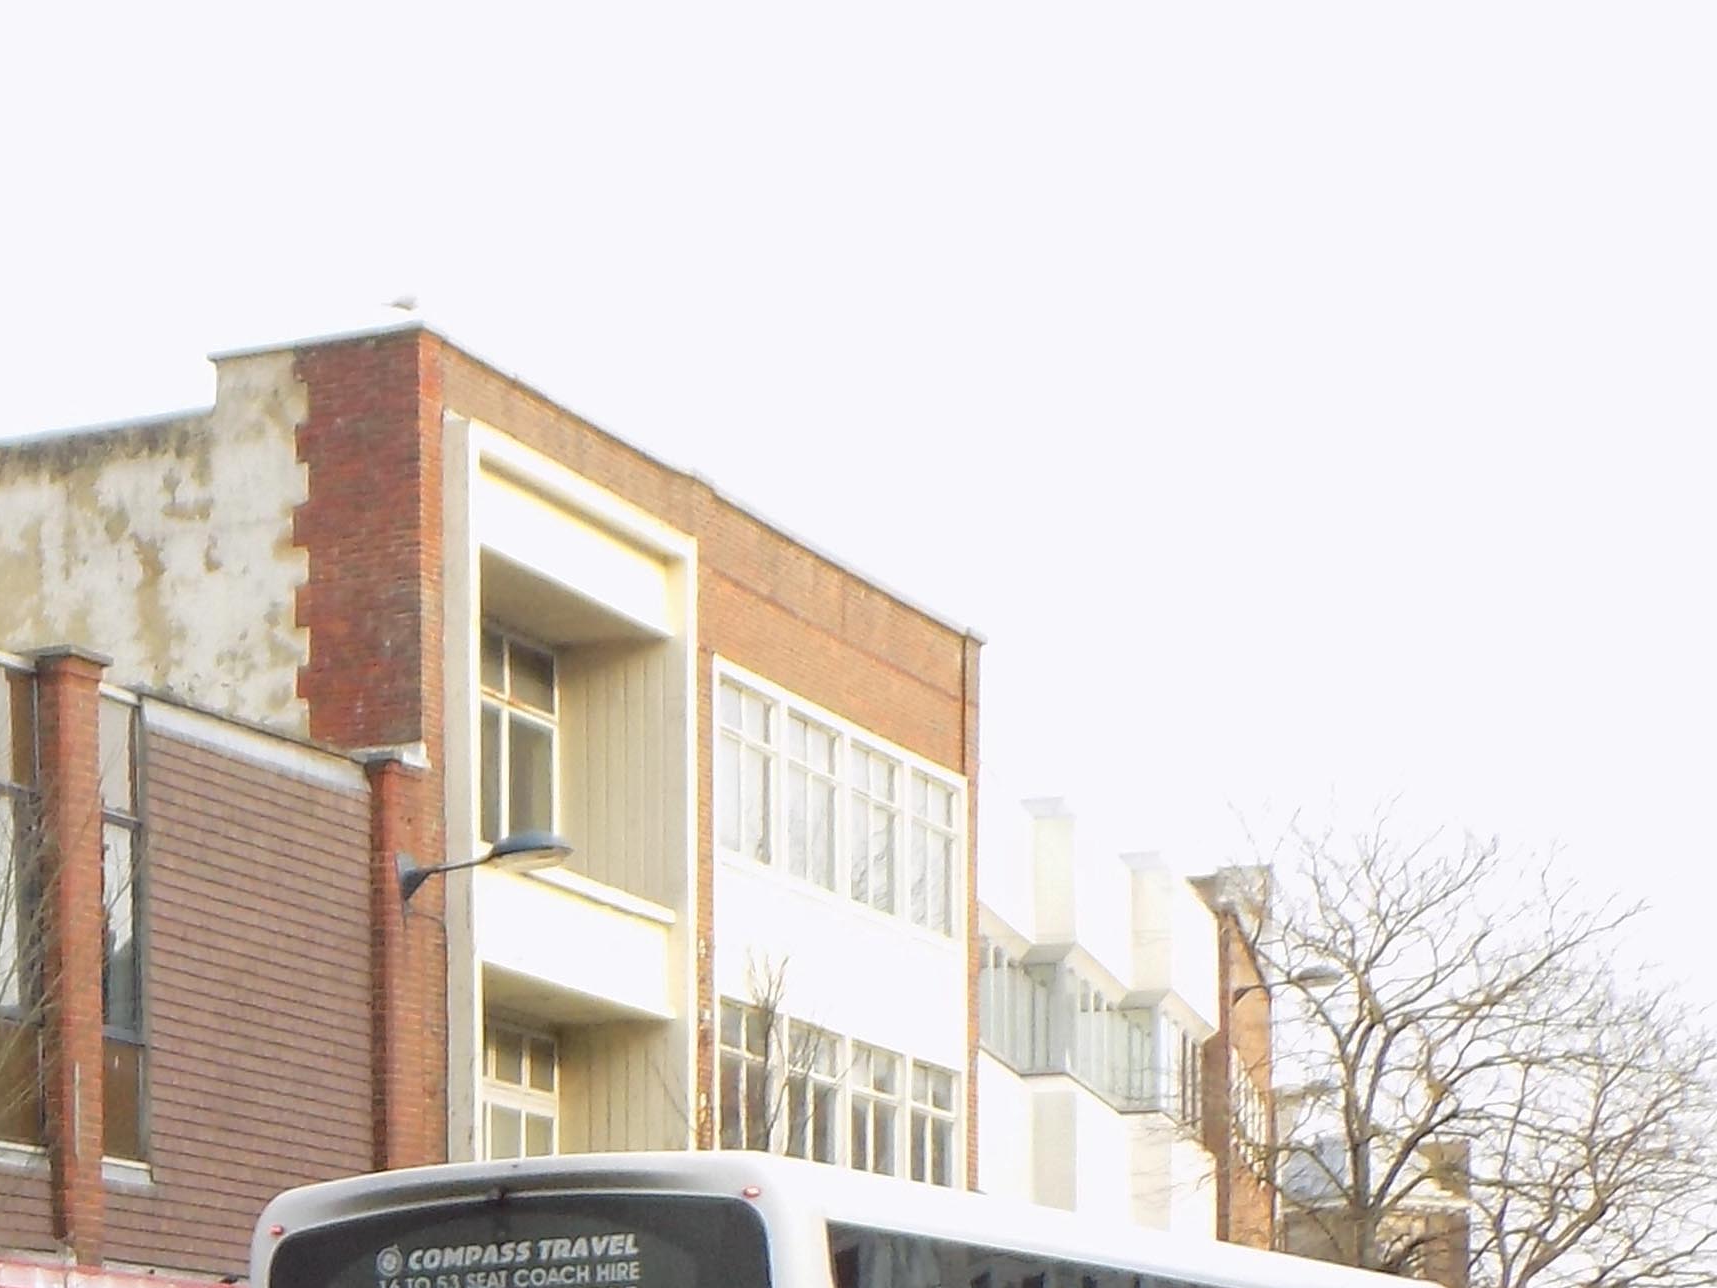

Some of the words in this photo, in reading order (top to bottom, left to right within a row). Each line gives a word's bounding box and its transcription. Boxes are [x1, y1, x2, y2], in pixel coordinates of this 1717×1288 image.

[407, 1240, 532, 1271] COMPASS
[536, 1233, 640, 1261] TRAVEL
[514, 1264, 591, 1288] COACH
[595, 1261, 641, 1282] HIRE
